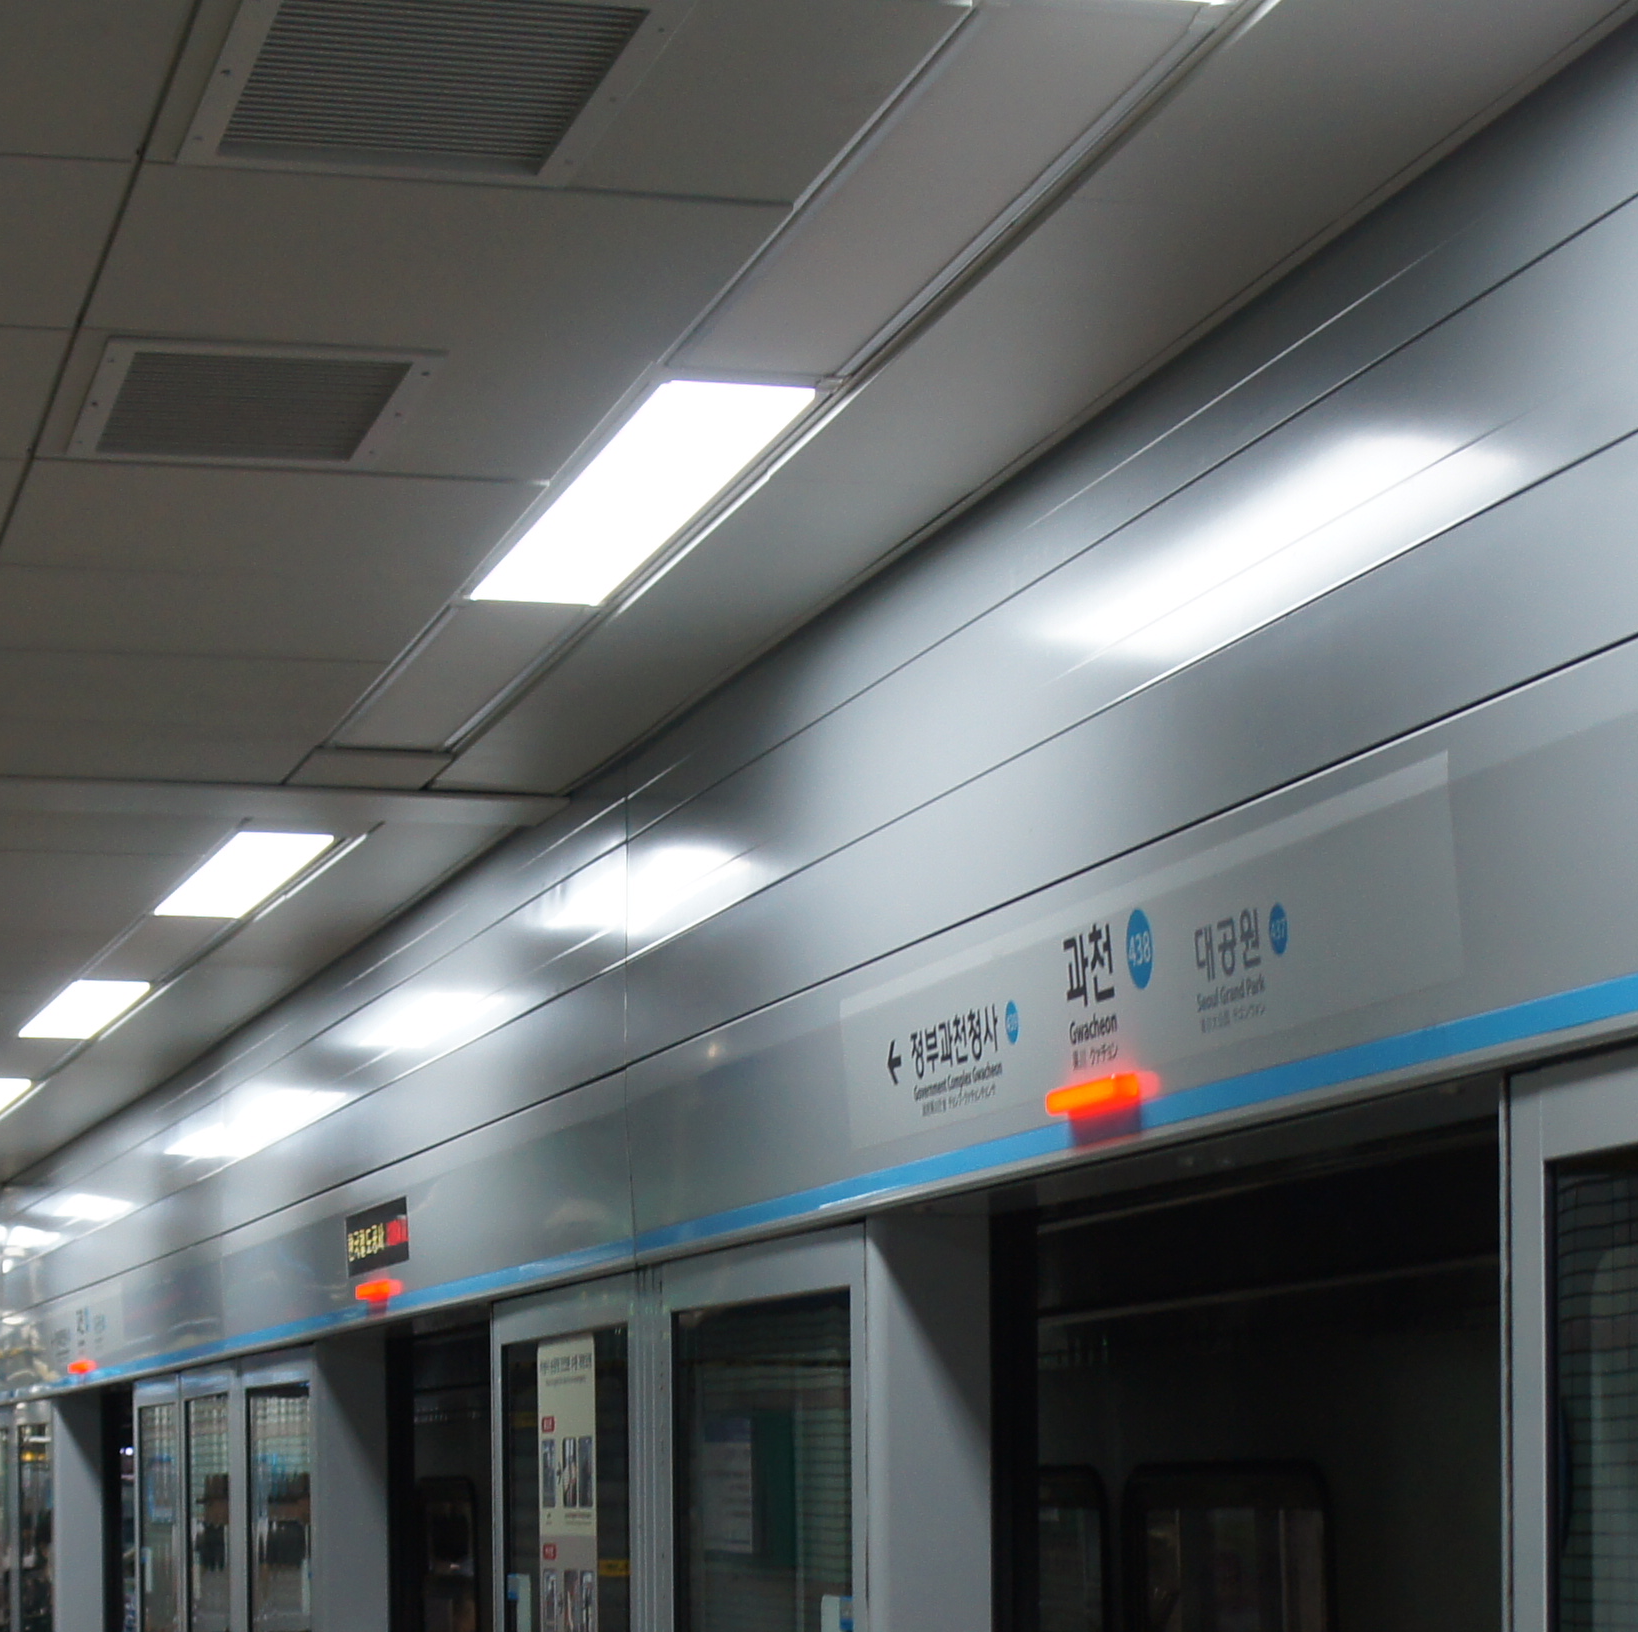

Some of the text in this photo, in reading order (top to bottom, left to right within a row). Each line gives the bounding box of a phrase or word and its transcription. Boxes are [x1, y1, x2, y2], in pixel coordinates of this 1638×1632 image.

[1063, 922, 1115, 1007] 과천
[1128, 931, 1151, 967] 438
[1194, 908, 1261, 982] 대공원
[910, 1003, 998, 1079] 정부과천청사
[1069, 1012, 1118, 1045] Gwacheon
